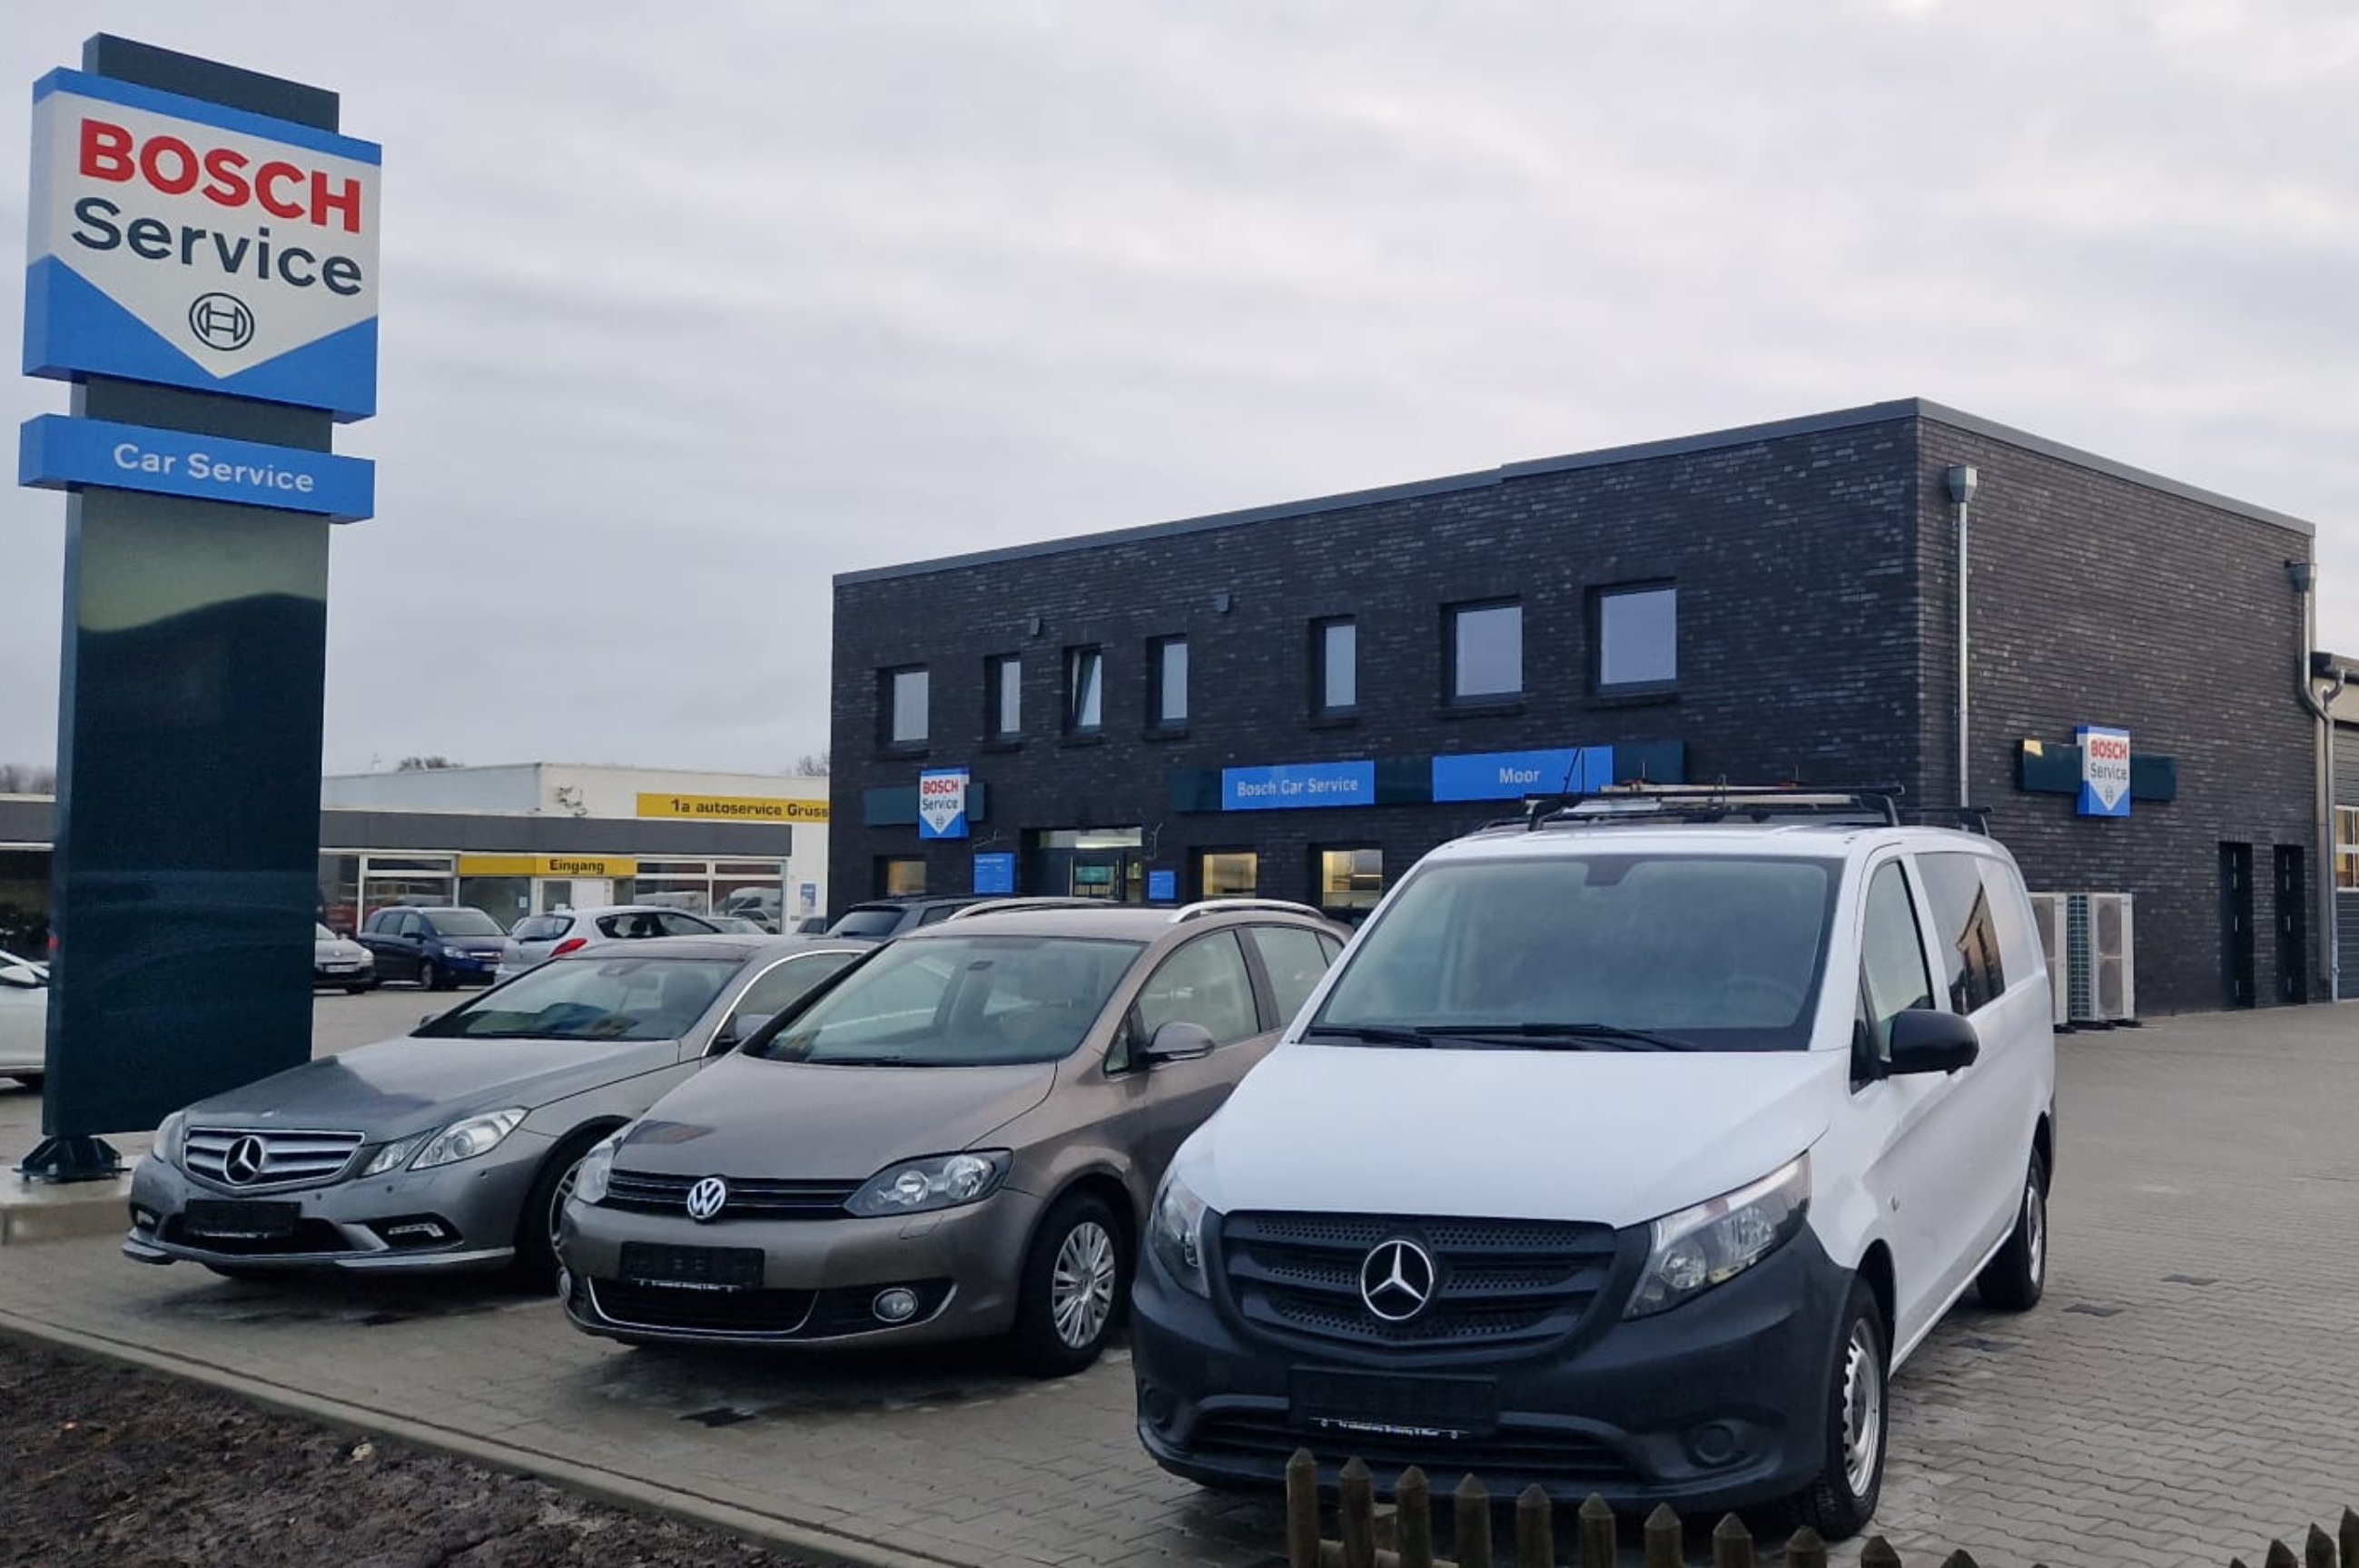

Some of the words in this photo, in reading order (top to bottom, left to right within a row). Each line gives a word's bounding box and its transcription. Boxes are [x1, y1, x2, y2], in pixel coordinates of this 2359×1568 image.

[79, 117, 361, 234] BOSCH
[71, 196, 362, 296] Service
[113, 442, 177, 475] Car
[187, 452, 315, 493] Service
[2090, 739, 2127, 760] BOSCH
[1499, 767, 1541, 784] Moor
[2090, 762, 2127, 781] Service
[923, 779, 959, 795] BOSCH
[1237, 780, 1276, 797] Bosch
[1281, 778, 1302, 795] Car
[1308, 776, 1358, 793] Service
[670, 797, 690, 813] 1a
[696, 802, 783, 816] autoservice
[922, 797, 958, 812] Service
[549, 858, 606, 875] Eingang
[687, 1178, 726, 1219] VW
